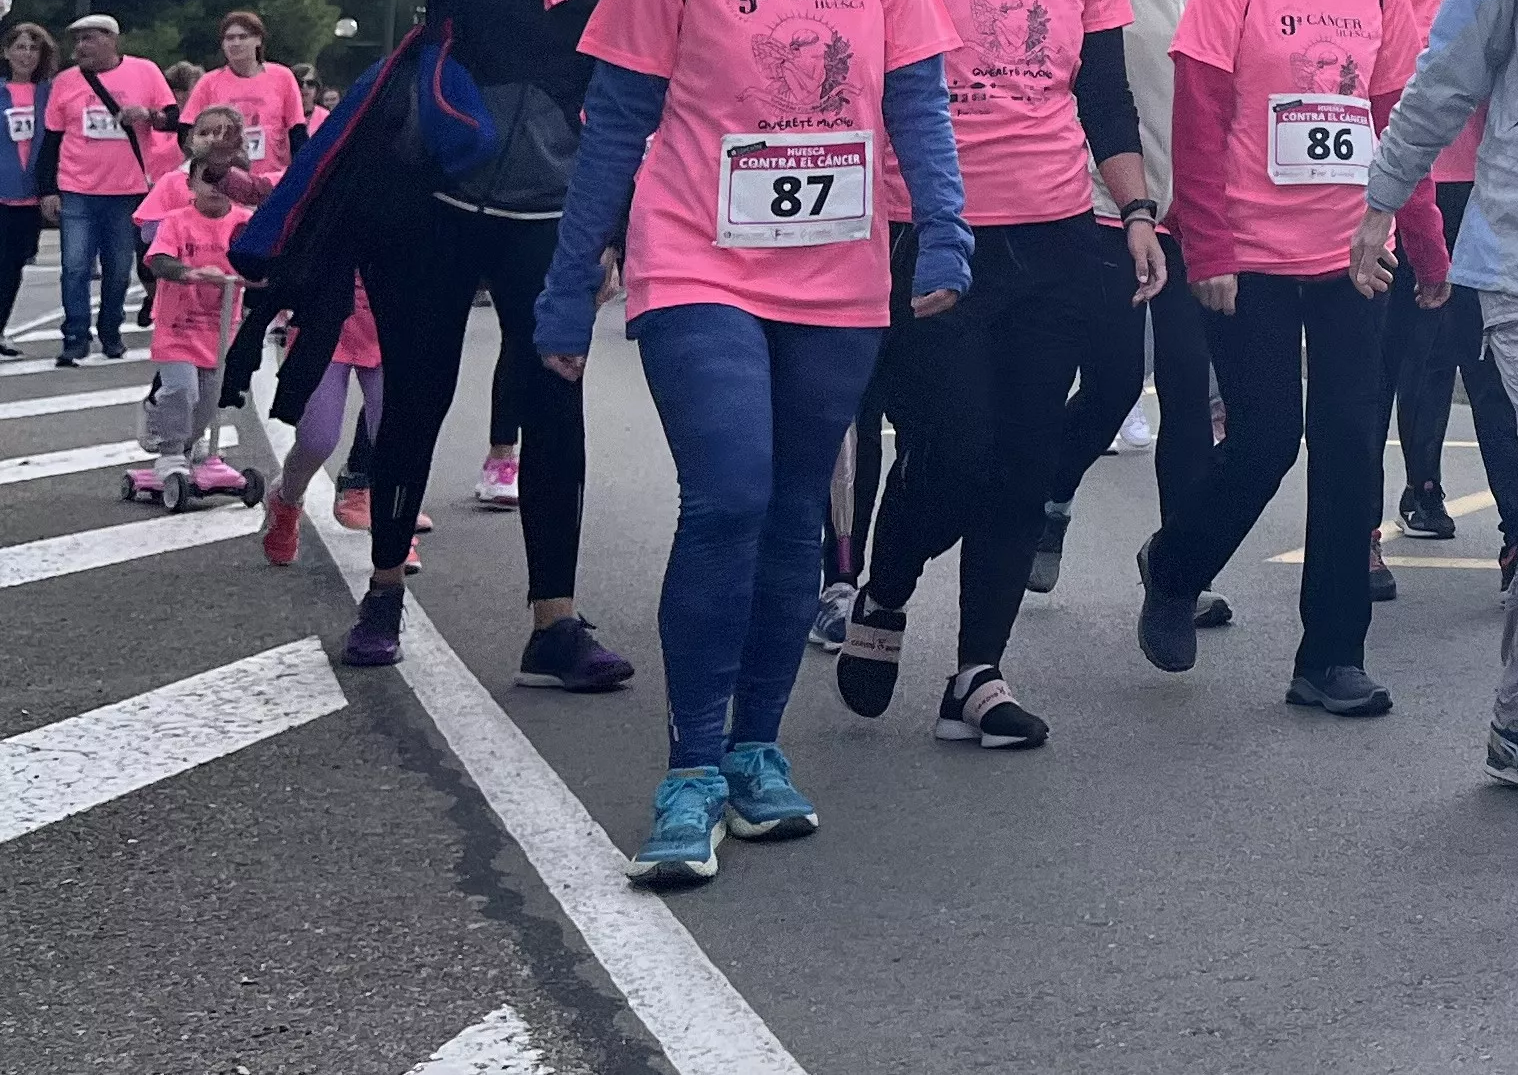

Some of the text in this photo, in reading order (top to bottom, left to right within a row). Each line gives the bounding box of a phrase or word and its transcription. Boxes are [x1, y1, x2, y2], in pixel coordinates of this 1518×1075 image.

[814, 0, 865, 10] HUESCA
[1306, 12, 1362, 30] CÁNCER
[1282, 112, 1326, 122] CONTRA
[1327, 113, 1338, 122] EL
[787, 146, 825, 157] HUESCA
[1306, 126, 1354, 161] 86
[739, 152, 861, 169] CONTRA EL CÁNCER
[770, 174, 835, 218] 87
